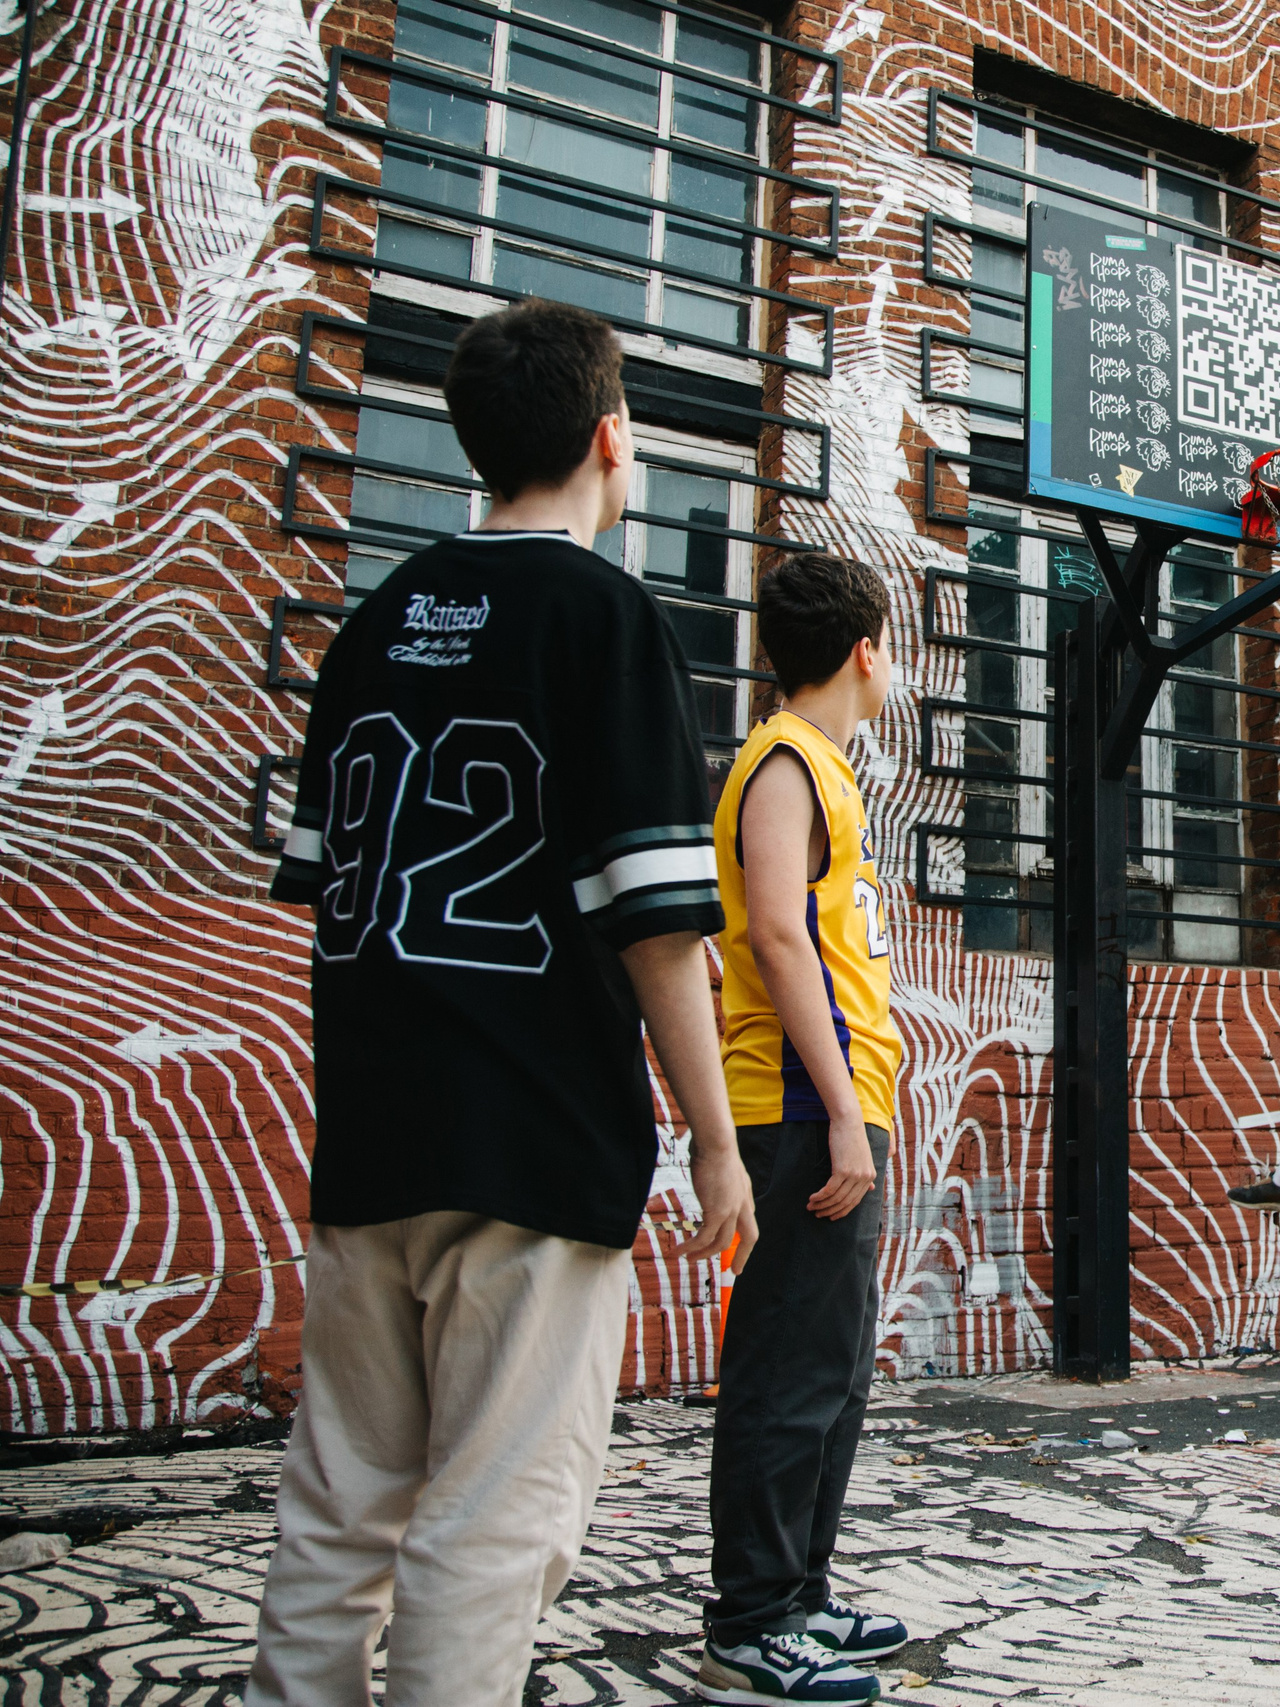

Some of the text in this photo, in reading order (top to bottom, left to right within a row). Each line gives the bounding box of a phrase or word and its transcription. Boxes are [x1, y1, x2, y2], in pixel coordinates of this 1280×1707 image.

[1090, 252, 1126, 275] PUMA
[1097, 264, 1131, 282] HOOPS
[1090, 283, 1126, 306] PUMA
[1097, 295, 1131, 314] HOOPS
[1090, 318, 1126, 341] PUMA
[1097, 330, 1131, 349] HOOPS
[1090, 354, 1126, 377] PUMA
[1097, 366, 1131, 385] HOOPS
[1090, 390, 1126, 414] PUMA
[1096, 403, 1131, 421] HOOPS
[1089, 427, 1125, 452] PUMA
[1096, 440, 1131, 459] HOOPS
[1179, 432, 1213, 455] PUMA
[1185, 444, 1218, 462] HOOPS
[1179, 468, 1213, 491] PUMA
[1185, 480, 1218, 499] HOOPS
[403, 593, 491, 632] Raised
[314, 711, 553, 974] 92
